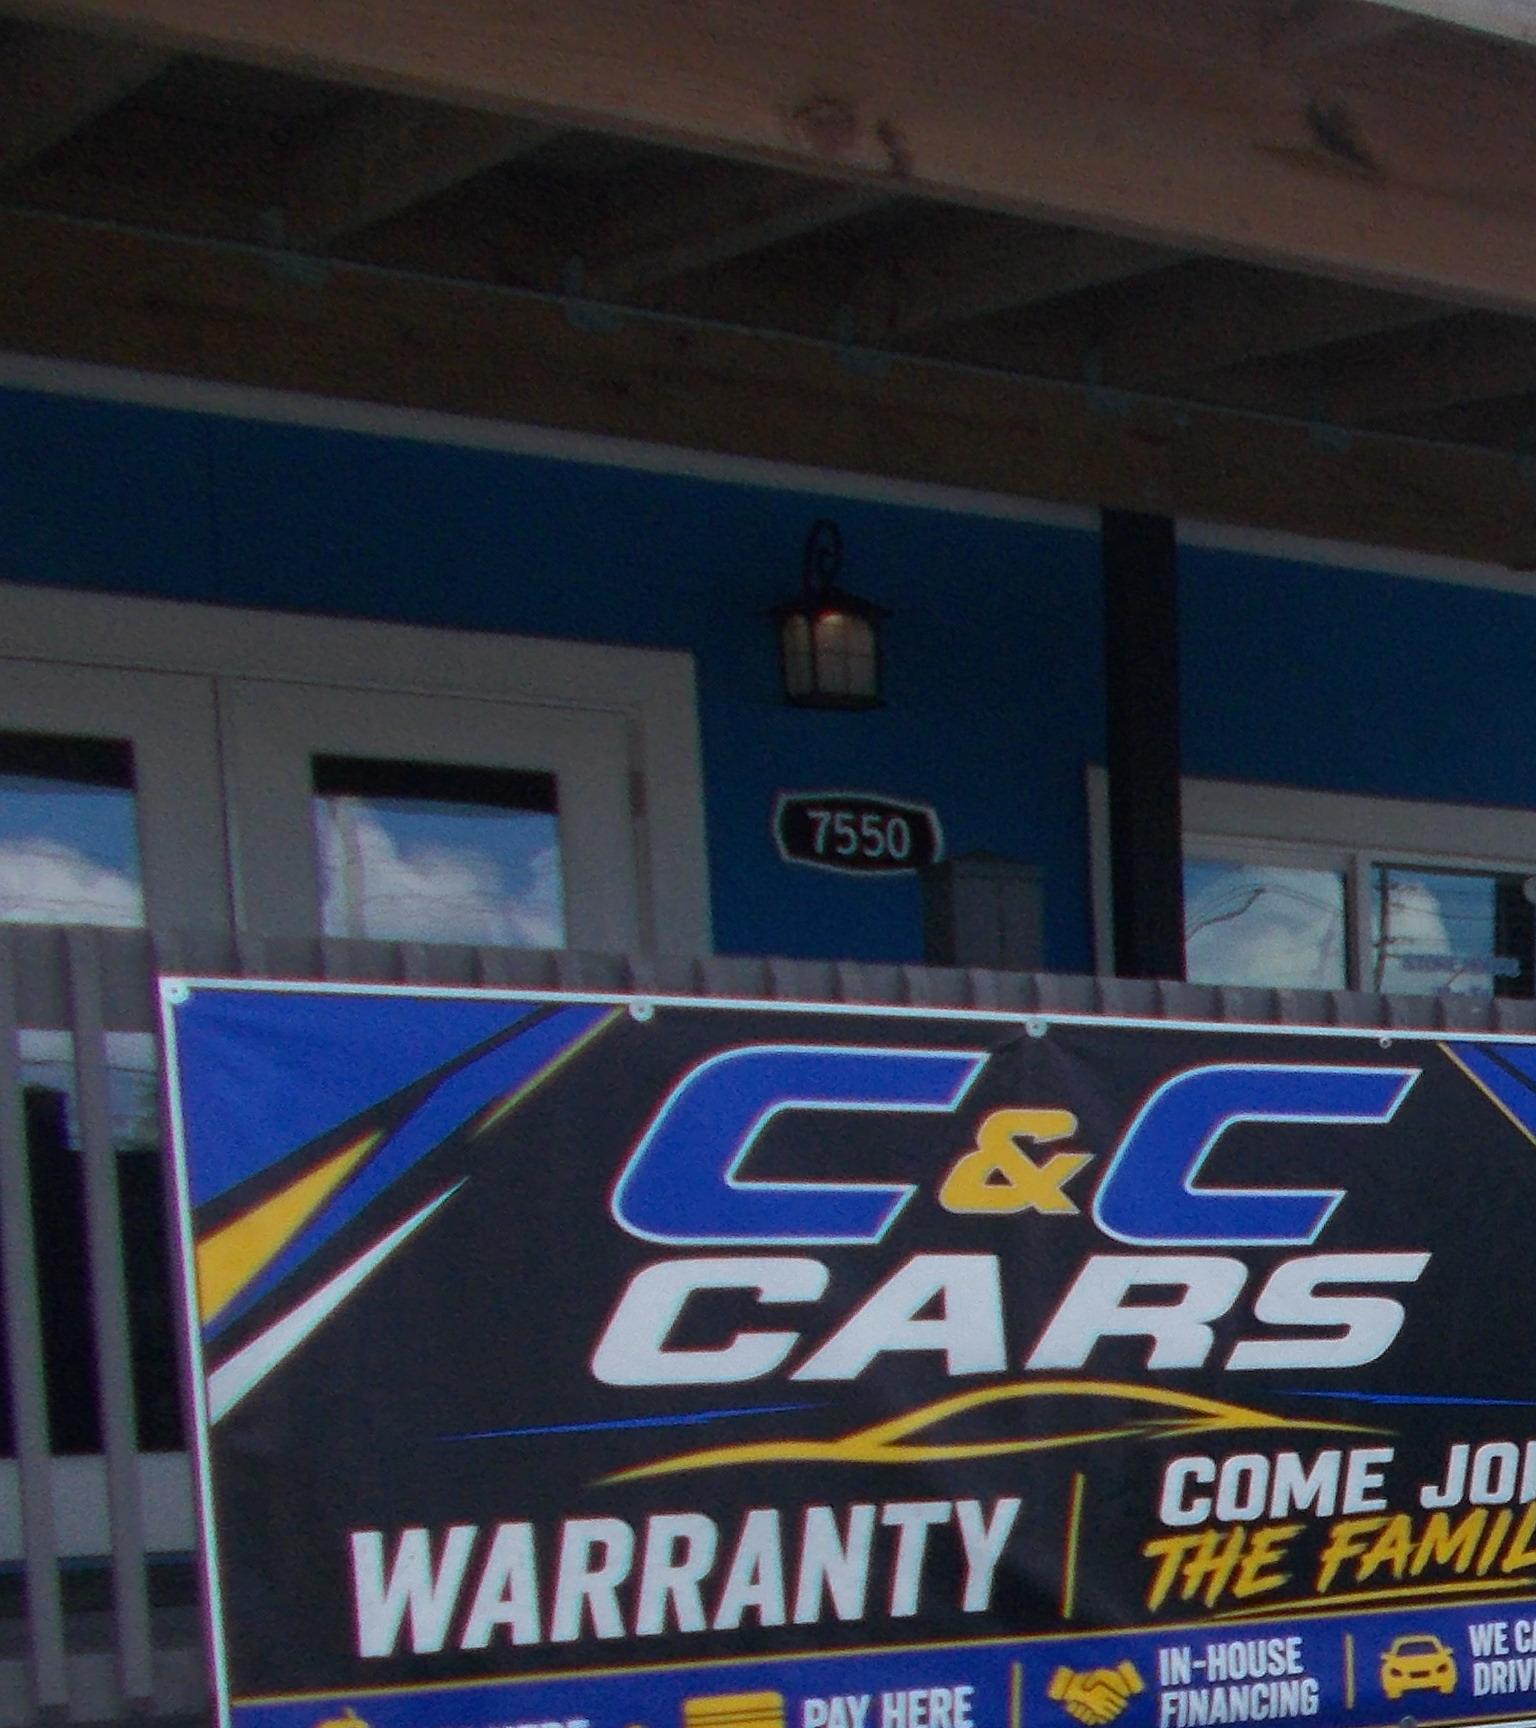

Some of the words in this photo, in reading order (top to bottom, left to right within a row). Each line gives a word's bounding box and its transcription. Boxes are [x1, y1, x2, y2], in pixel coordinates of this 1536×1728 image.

[807, 811, 910, 860] 7550
[613, 1044, 991, 1245] C
[938, 1108, 1093, 1216] &
[1093, 1063, 1422, 1246] C
[591, 1253, 1432, 1386] CARS
[1159, 1448, 1395, 1527] COME
[351, 1497, 1021, 1660] WARRANTY
[1142, 1523, 1308, 1612] THE
[1159, 1636, 1304, 1687] IN-HOUSE
[1468, 1621, 1510, 1657] WE
